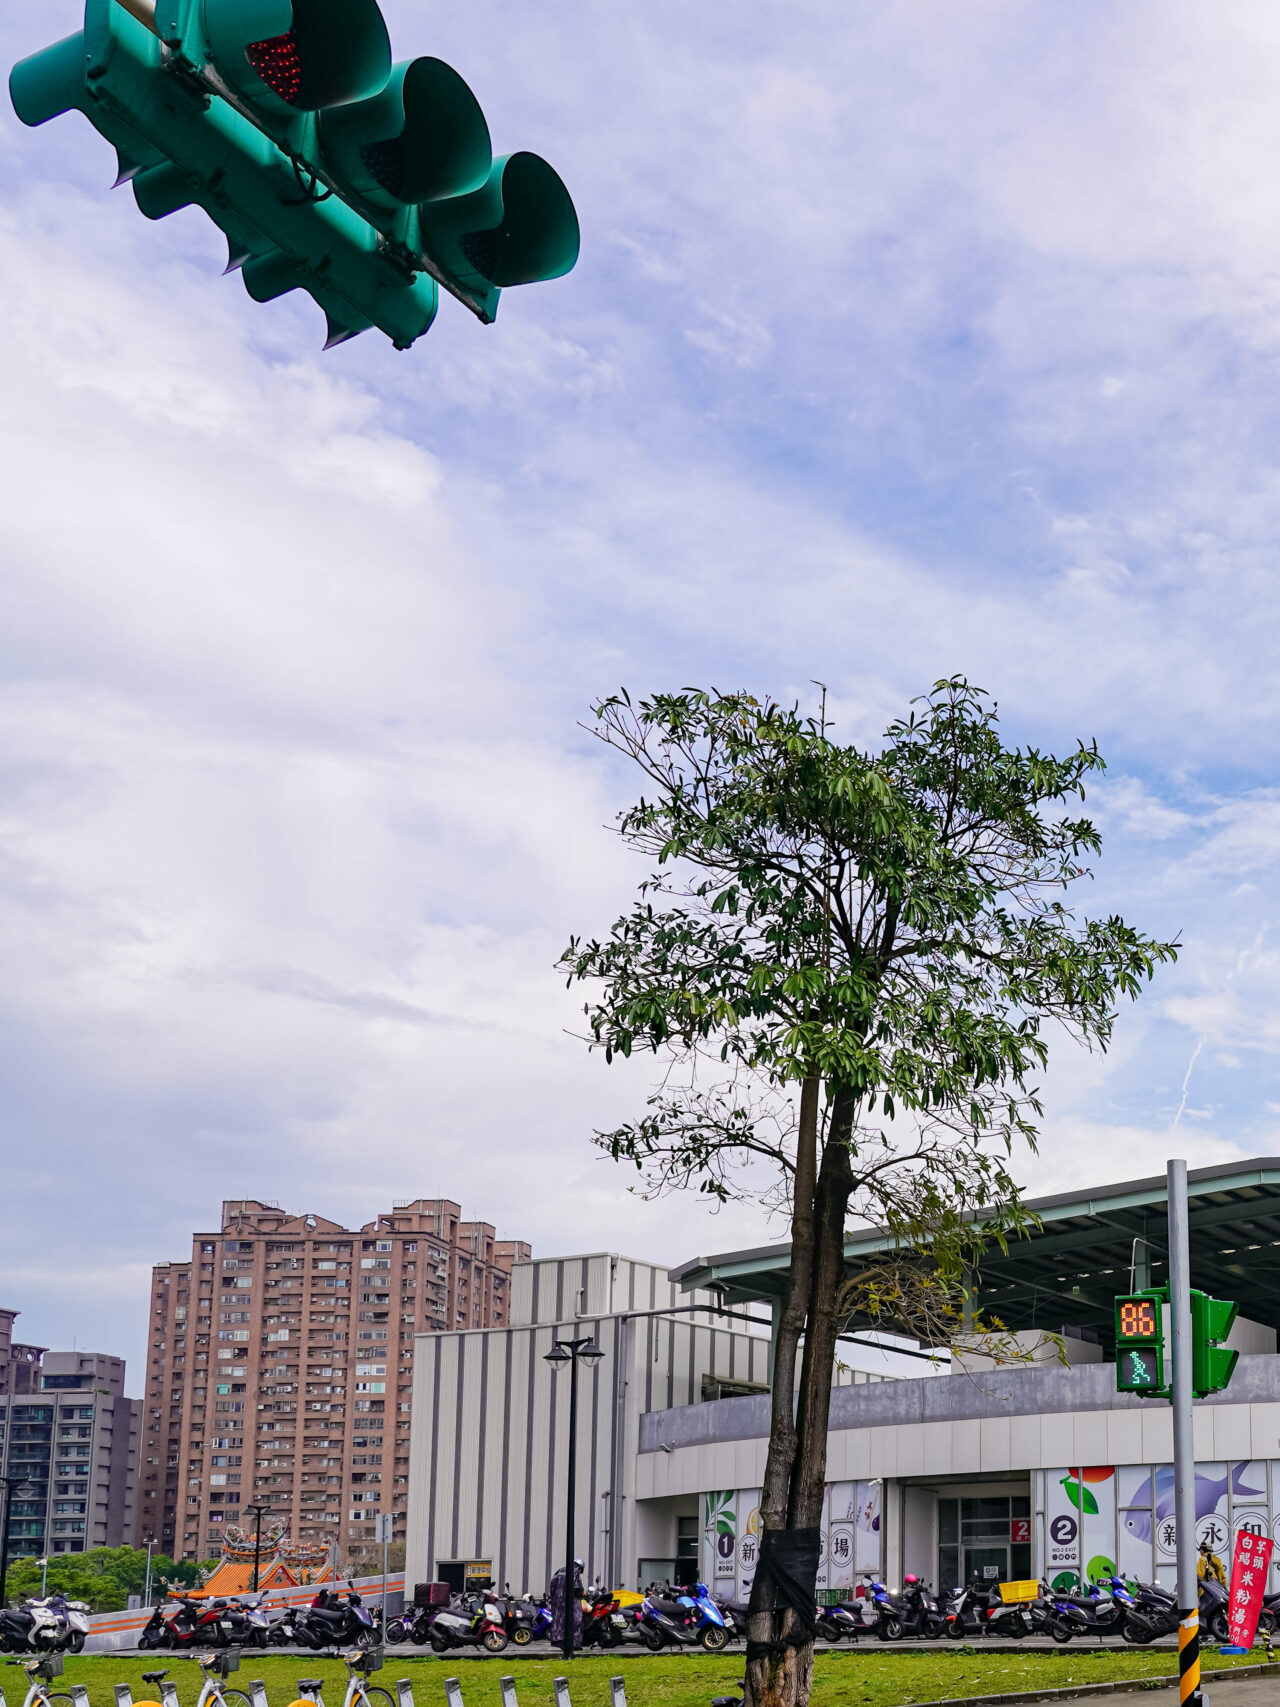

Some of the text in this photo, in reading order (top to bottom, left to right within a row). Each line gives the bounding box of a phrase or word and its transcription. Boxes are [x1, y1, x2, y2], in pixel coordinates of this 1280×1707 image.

[1121, 1303, 1154, 1336] 86
[1018, 1521, 1028, 1536] 2
[1057, 1520, 1072, 1540] 2
